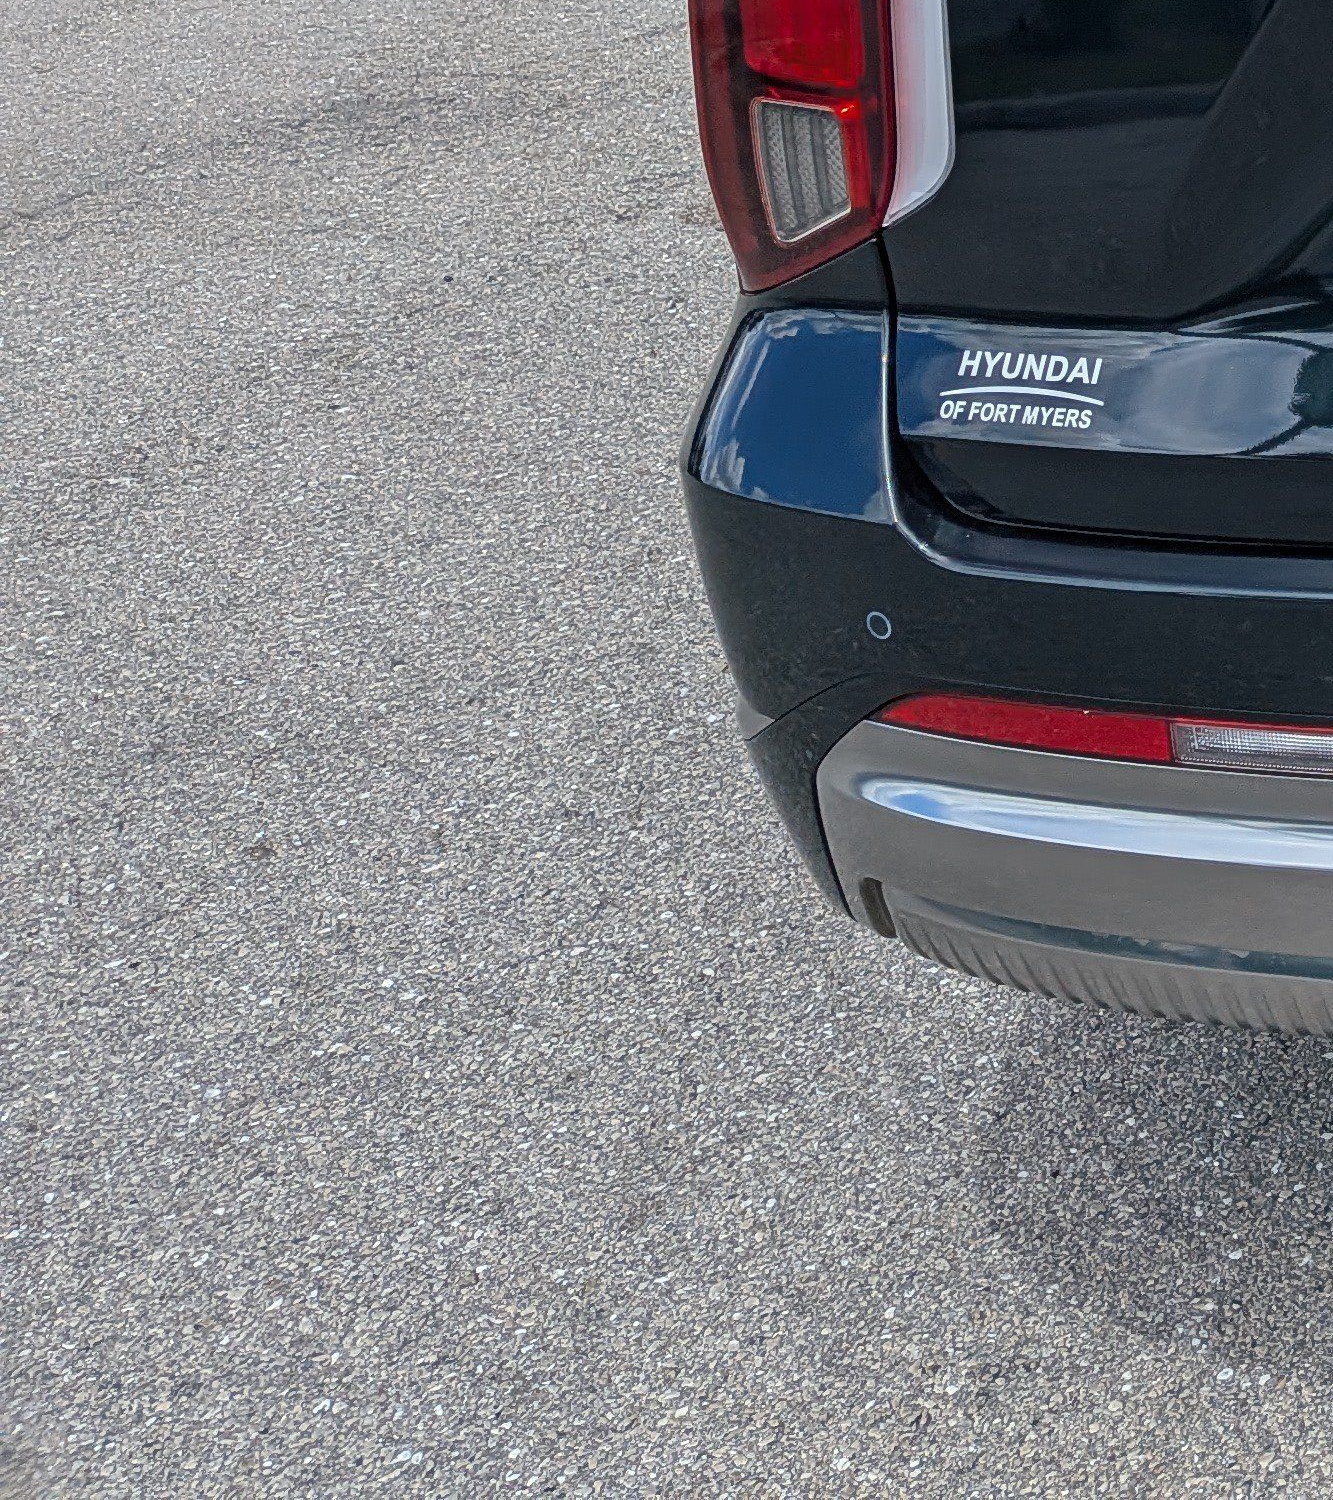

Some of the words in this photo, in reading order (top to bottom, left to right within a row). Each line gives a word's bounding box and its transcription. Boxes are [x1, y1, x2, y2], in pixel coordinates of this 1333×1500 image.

[957, 349, 1103, 385] HYUNDAI
[939, 400, 966, 420] OF
[967, 401, 1021, 424] FORT
[1021, 405, 1093, 429] MYERS
